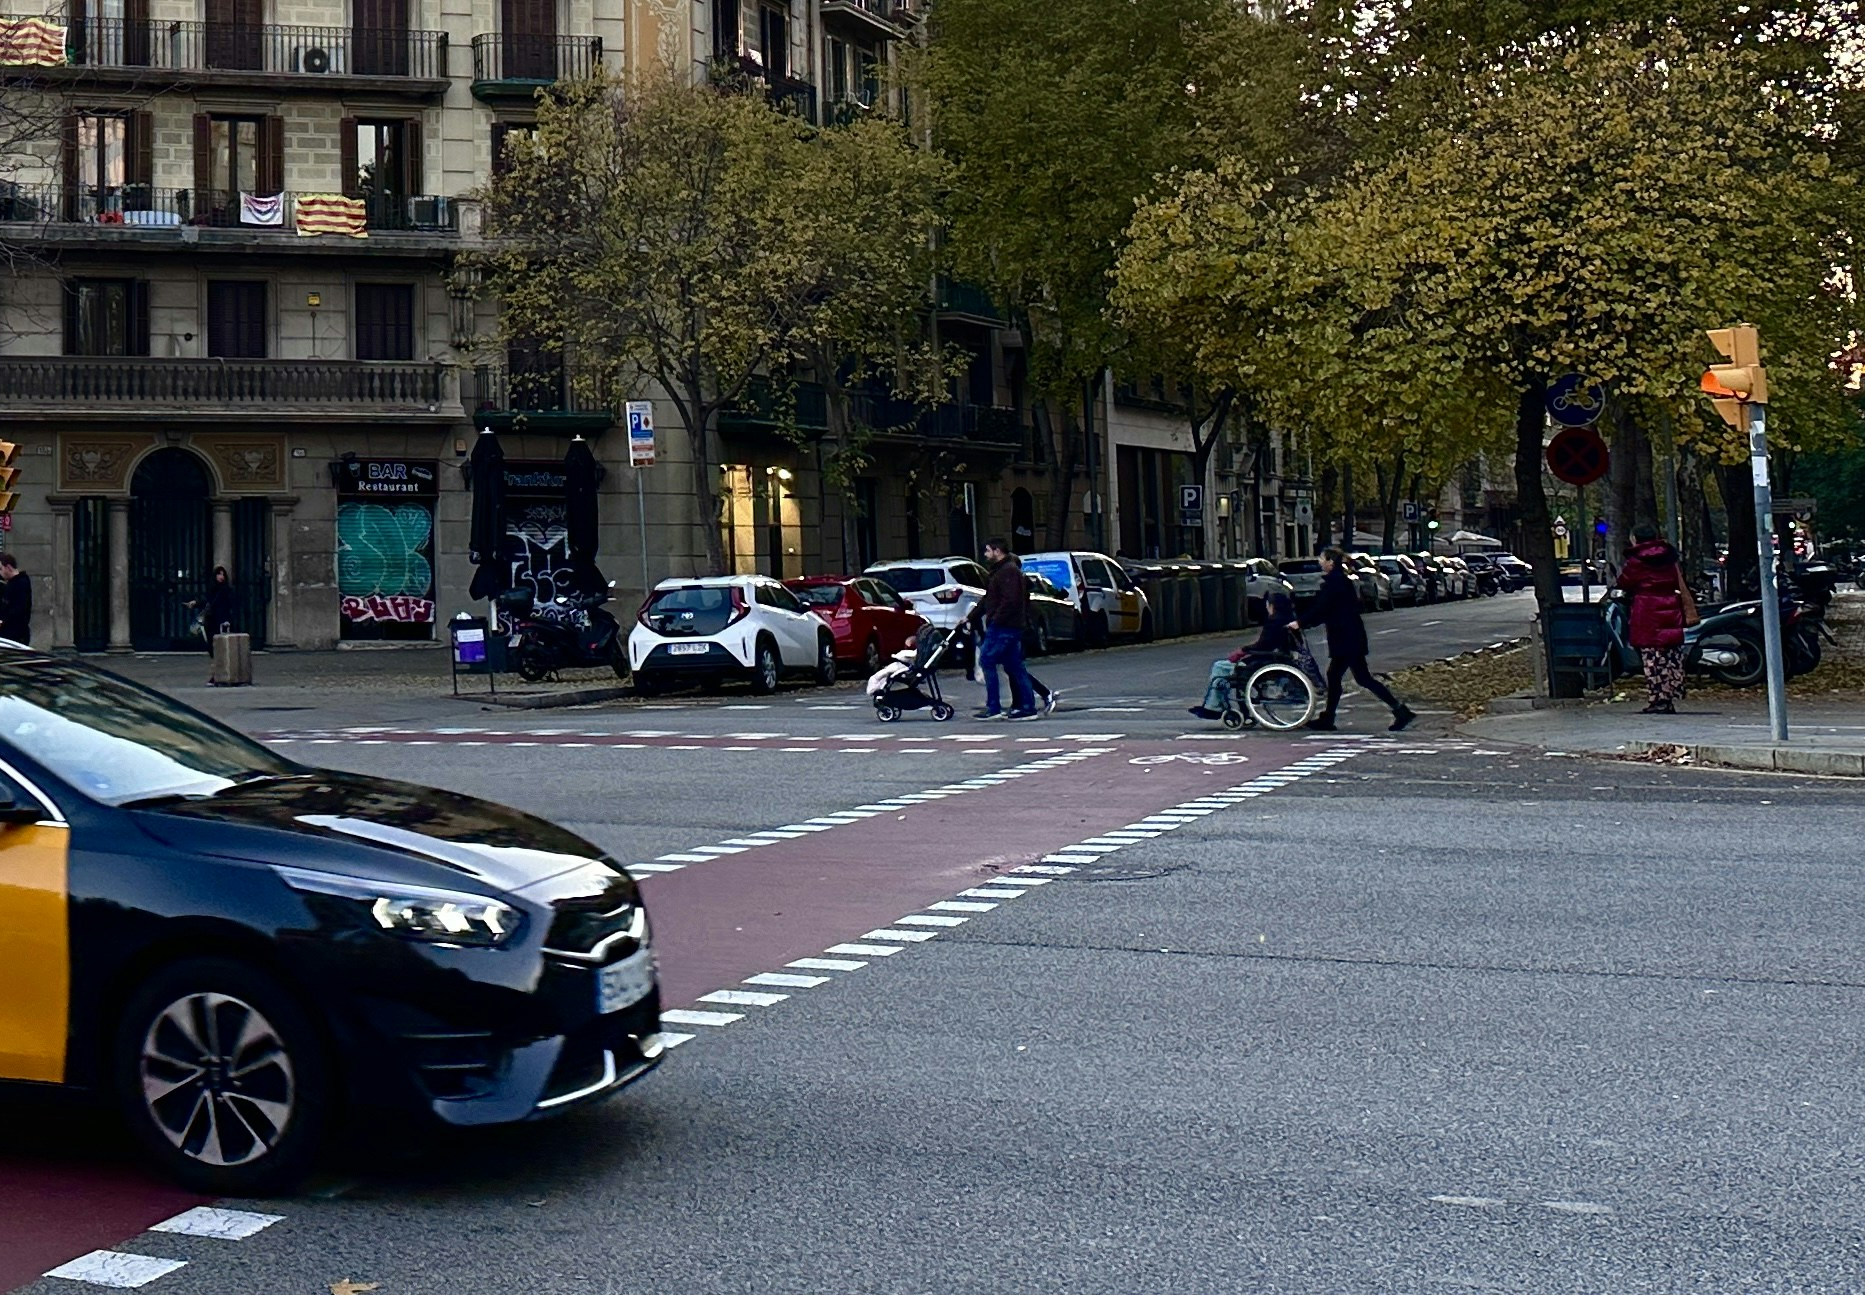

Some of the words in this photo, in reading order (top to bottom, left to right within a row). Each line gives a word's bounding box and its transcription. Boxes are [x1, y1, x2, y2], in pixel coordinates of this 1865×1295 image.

[632, 414, 639, 429] P
[368, 463, 408, 480] BAR
[358, 480, 419, 492] Restaurant
[1184, 489, 1196, 506] P
